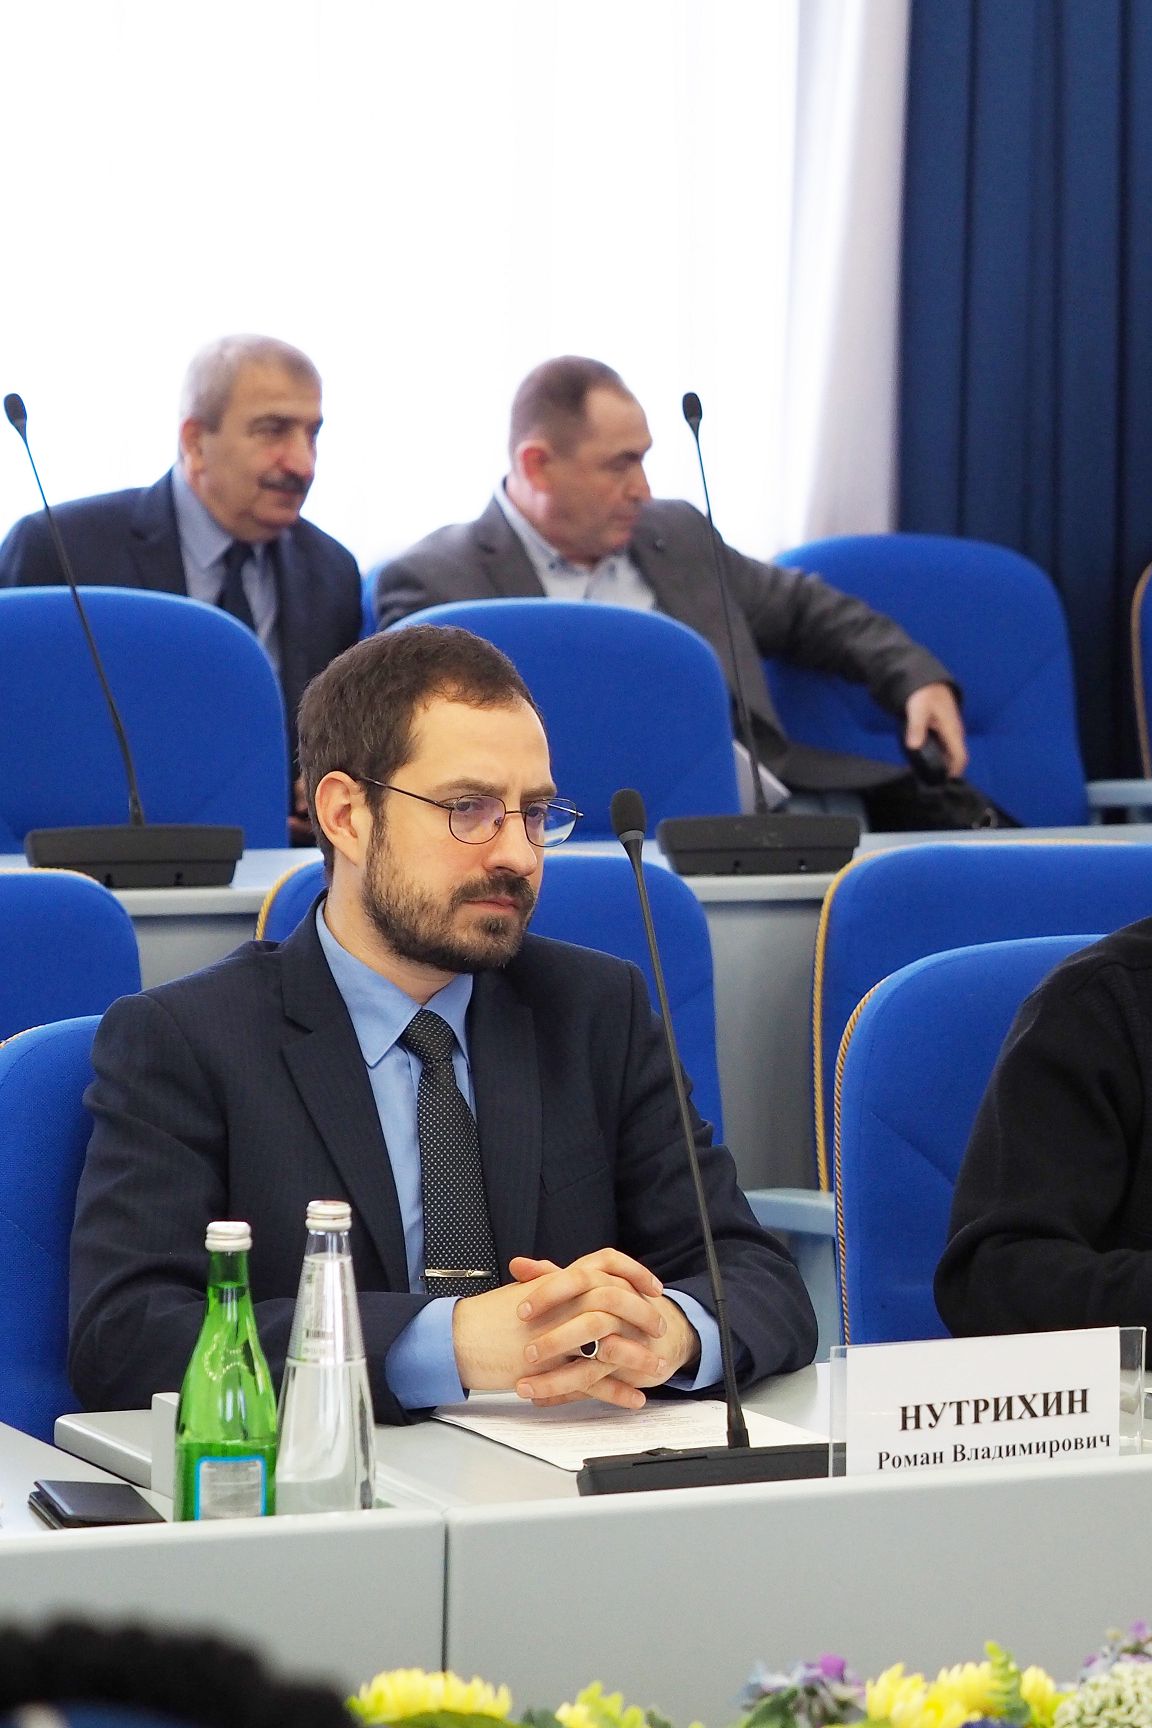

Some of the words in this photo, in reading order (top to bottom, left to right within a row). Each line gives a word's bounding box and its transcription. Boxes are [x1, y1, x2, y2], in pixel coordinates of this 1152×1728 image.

[900, 1388, 1089, 1431] НУТРИХИН
[878, 1451, 944, 1470] Роман
[952, 1434, 1111, 1463] Владимирович
